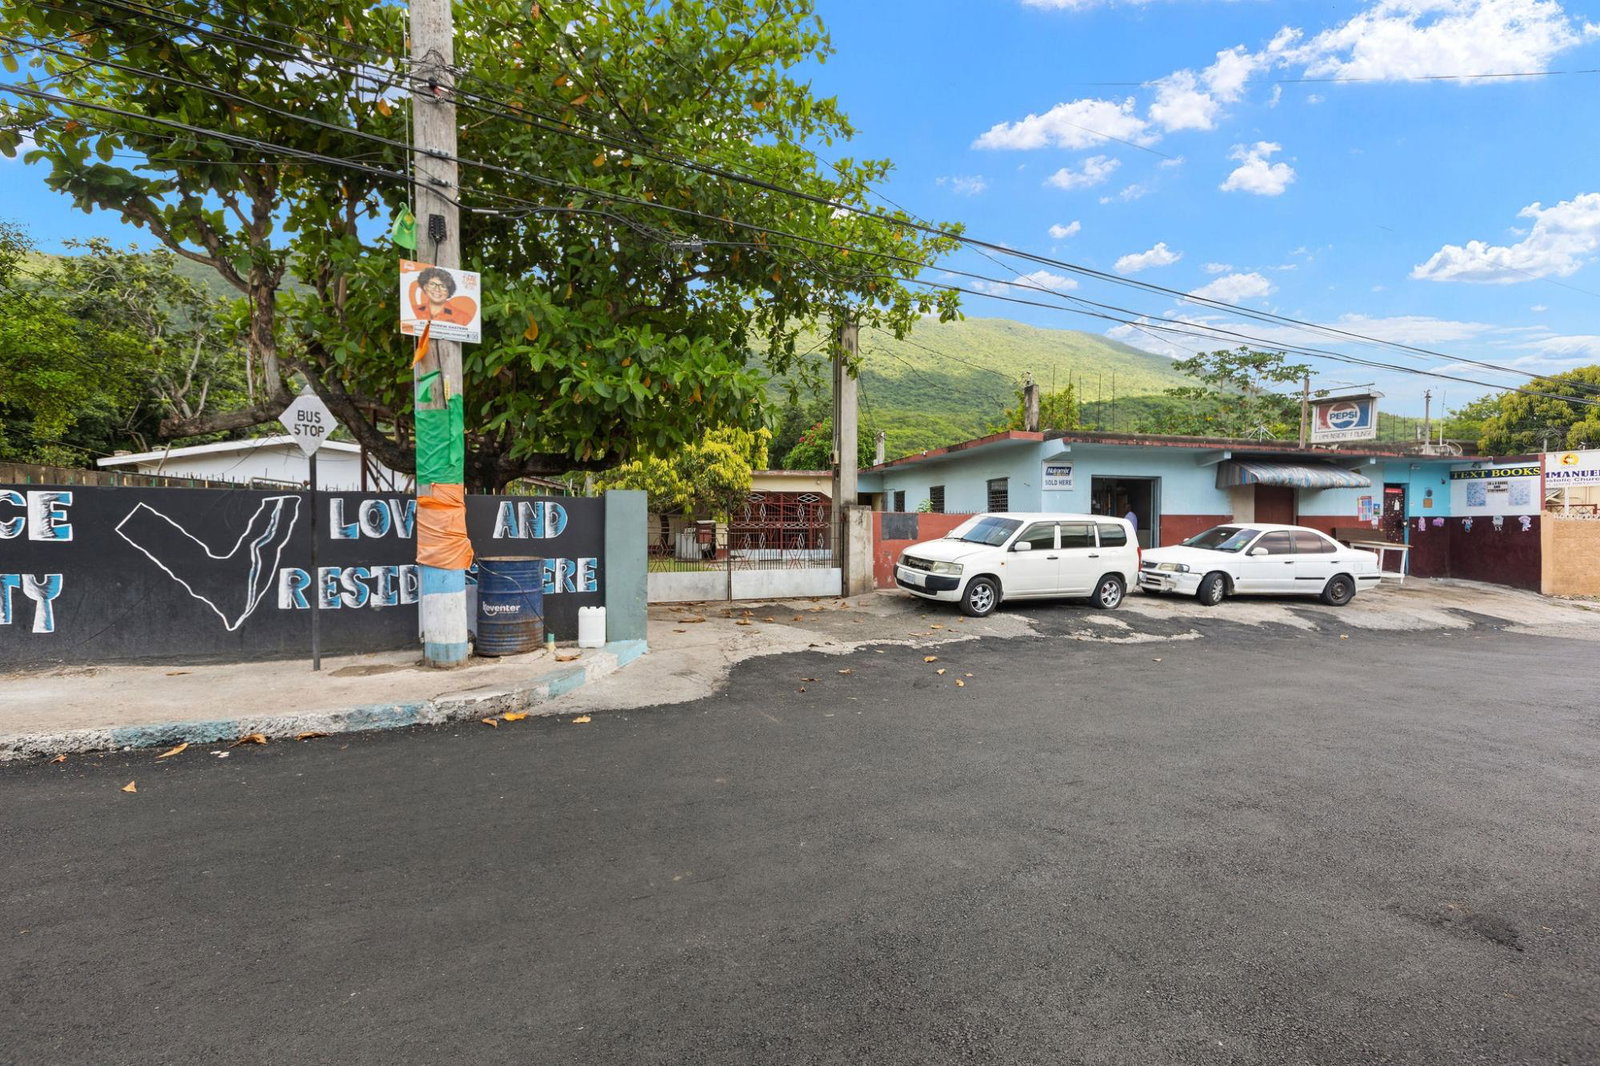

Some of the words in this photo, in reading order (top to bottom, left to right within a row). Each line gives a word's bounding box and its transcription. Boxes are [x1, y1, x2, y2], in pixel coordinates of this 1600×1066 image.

[297, 410, 321, 423] BUS
[1329, 410, 1358, 420] PEPSI
[294, 424, 325, 437] STOP
[1452, 470, 1488, 479] TEXT
[1491, 467, 1540, 478] BOOKS
[1545, 470, 1600, 479] MANUE
[330, 498, 417, 539] LOV
[493, 501, 569, 539] AND
[542, 557, 597, 594] ERE
